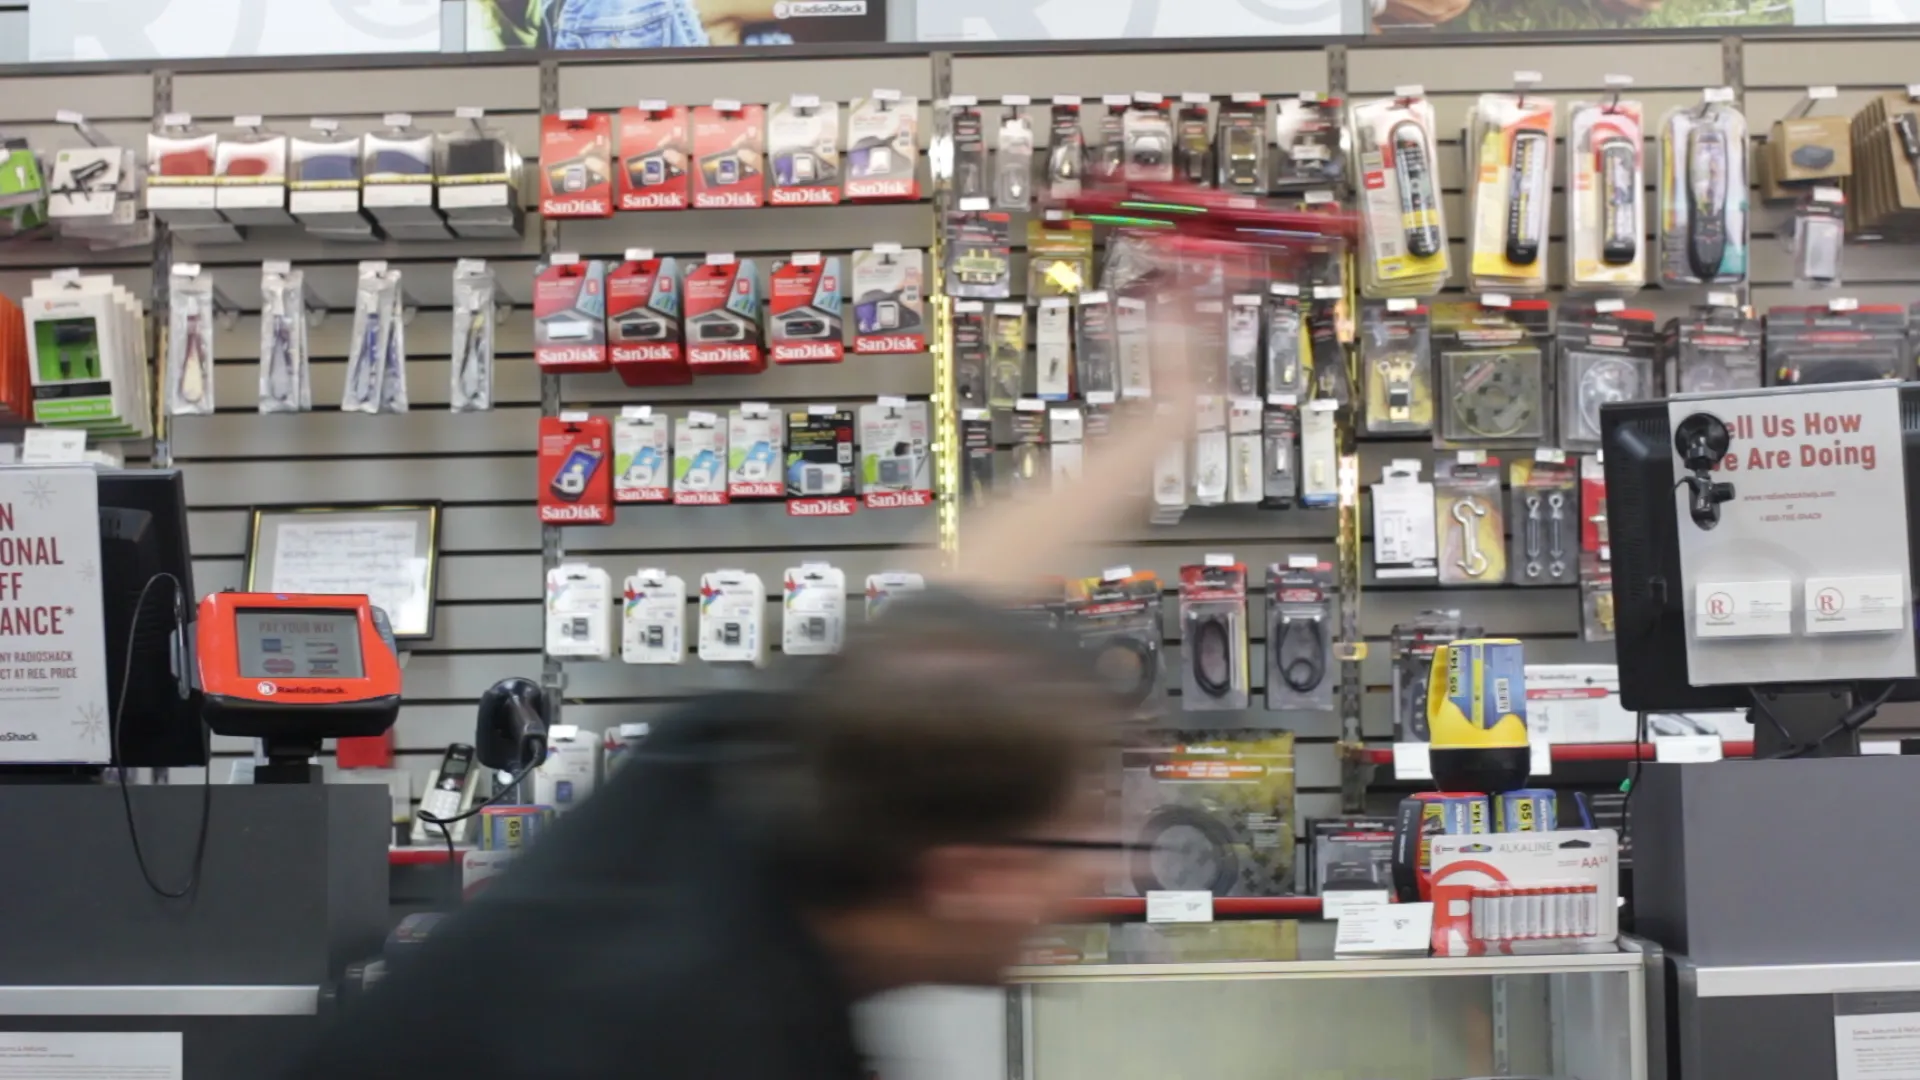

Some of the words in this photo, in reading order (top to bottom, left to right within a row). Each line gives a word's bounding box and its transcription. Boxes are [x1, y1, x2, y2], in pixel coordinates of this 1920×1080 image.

[793, 3, 863, 14] RadioShack
[847, 180, 910, 196] SanDisk
[622, 192, 684, 208] SanDisk
[695, 192, 758, 207] SanDisk
[771, 188, 834, 204] SanDisk
[544, 199, 605, 214] SanDisk
[856, 336, 917, 352] SanDisk
[539, 347, 602, 363] SanDisk
[612, 345, 674, 361] SanDisk
[688, 345, 752, 361] SanDisk
[774, 344, 838, 360] SanDisk
[1725, 415, 1753, 440] ell
[1762, 415, 1796, 437] Us
[1804, 412, 1862, 435] How
[1712, 451, 1738, 472] e
[1747, 447, 1791, 470] Are
[1800, 440, 1877, 470] Doing
[615, 488, 665, 501] SanDisk
[729, 483, 778, 495] SanDisk
[674, 491, 723, 504] SanDisk
[866, 493, 926, 508] SanDisk
[541, 504, 603, 521] SanDisk
[790, 500, 852, 515] SanDisk
[0, 537, 64, 566] ONAL
[313, 621, 334, 633] WAY
[14, 651, 73, 662] RADIOSHACK
[14, 668, 24, 679] AT
[50, 667, 78, 679] PRICE
[277, 686, 343, 695] RadioShack
[1500, 841, 1553, 853] ALKALINE
